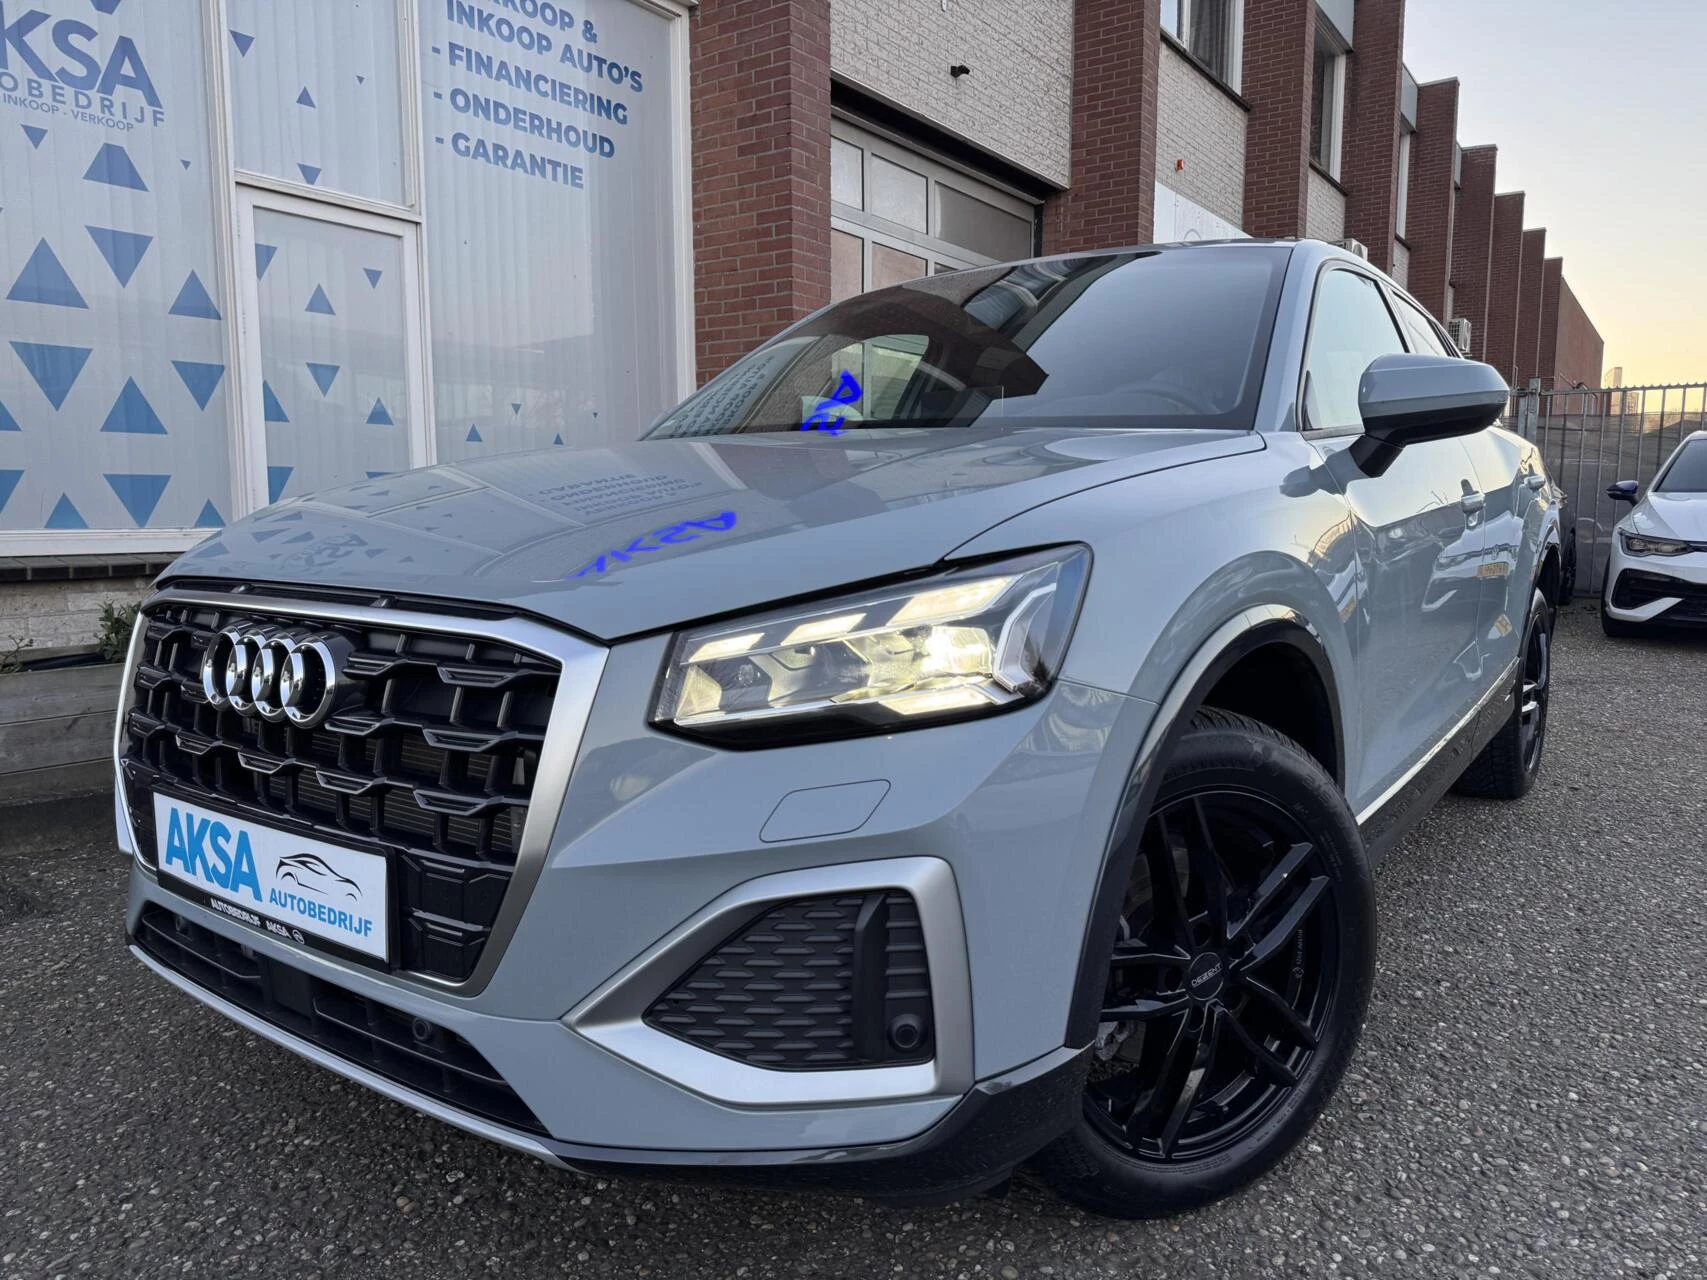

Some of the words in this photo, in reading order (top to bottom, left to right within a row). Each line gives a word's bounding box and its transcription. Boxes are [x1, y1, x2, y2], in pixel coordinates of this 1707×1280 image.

[447, 0, 552, 55] INKOOP
[560, 43, 643, 93] AUTO'S
[582, 19, 598, 43] &
[448, 42, 628, 125] FINANCIERING
[3, 93, 59, 115] INKOOP
[71, 109, 134, 132] VERKOOP
[450, 88, 615, 158] ONDERHOUD
[451, 132, 583, 189] GARANTIE
[165, 807, 263, 902] AKSA
[211, 898, 261, 927] AUTOBEDRIJF
[266, 920, 292, 939] AKSA
[269, 888, 372, 937] AUTOBEDRIJF
